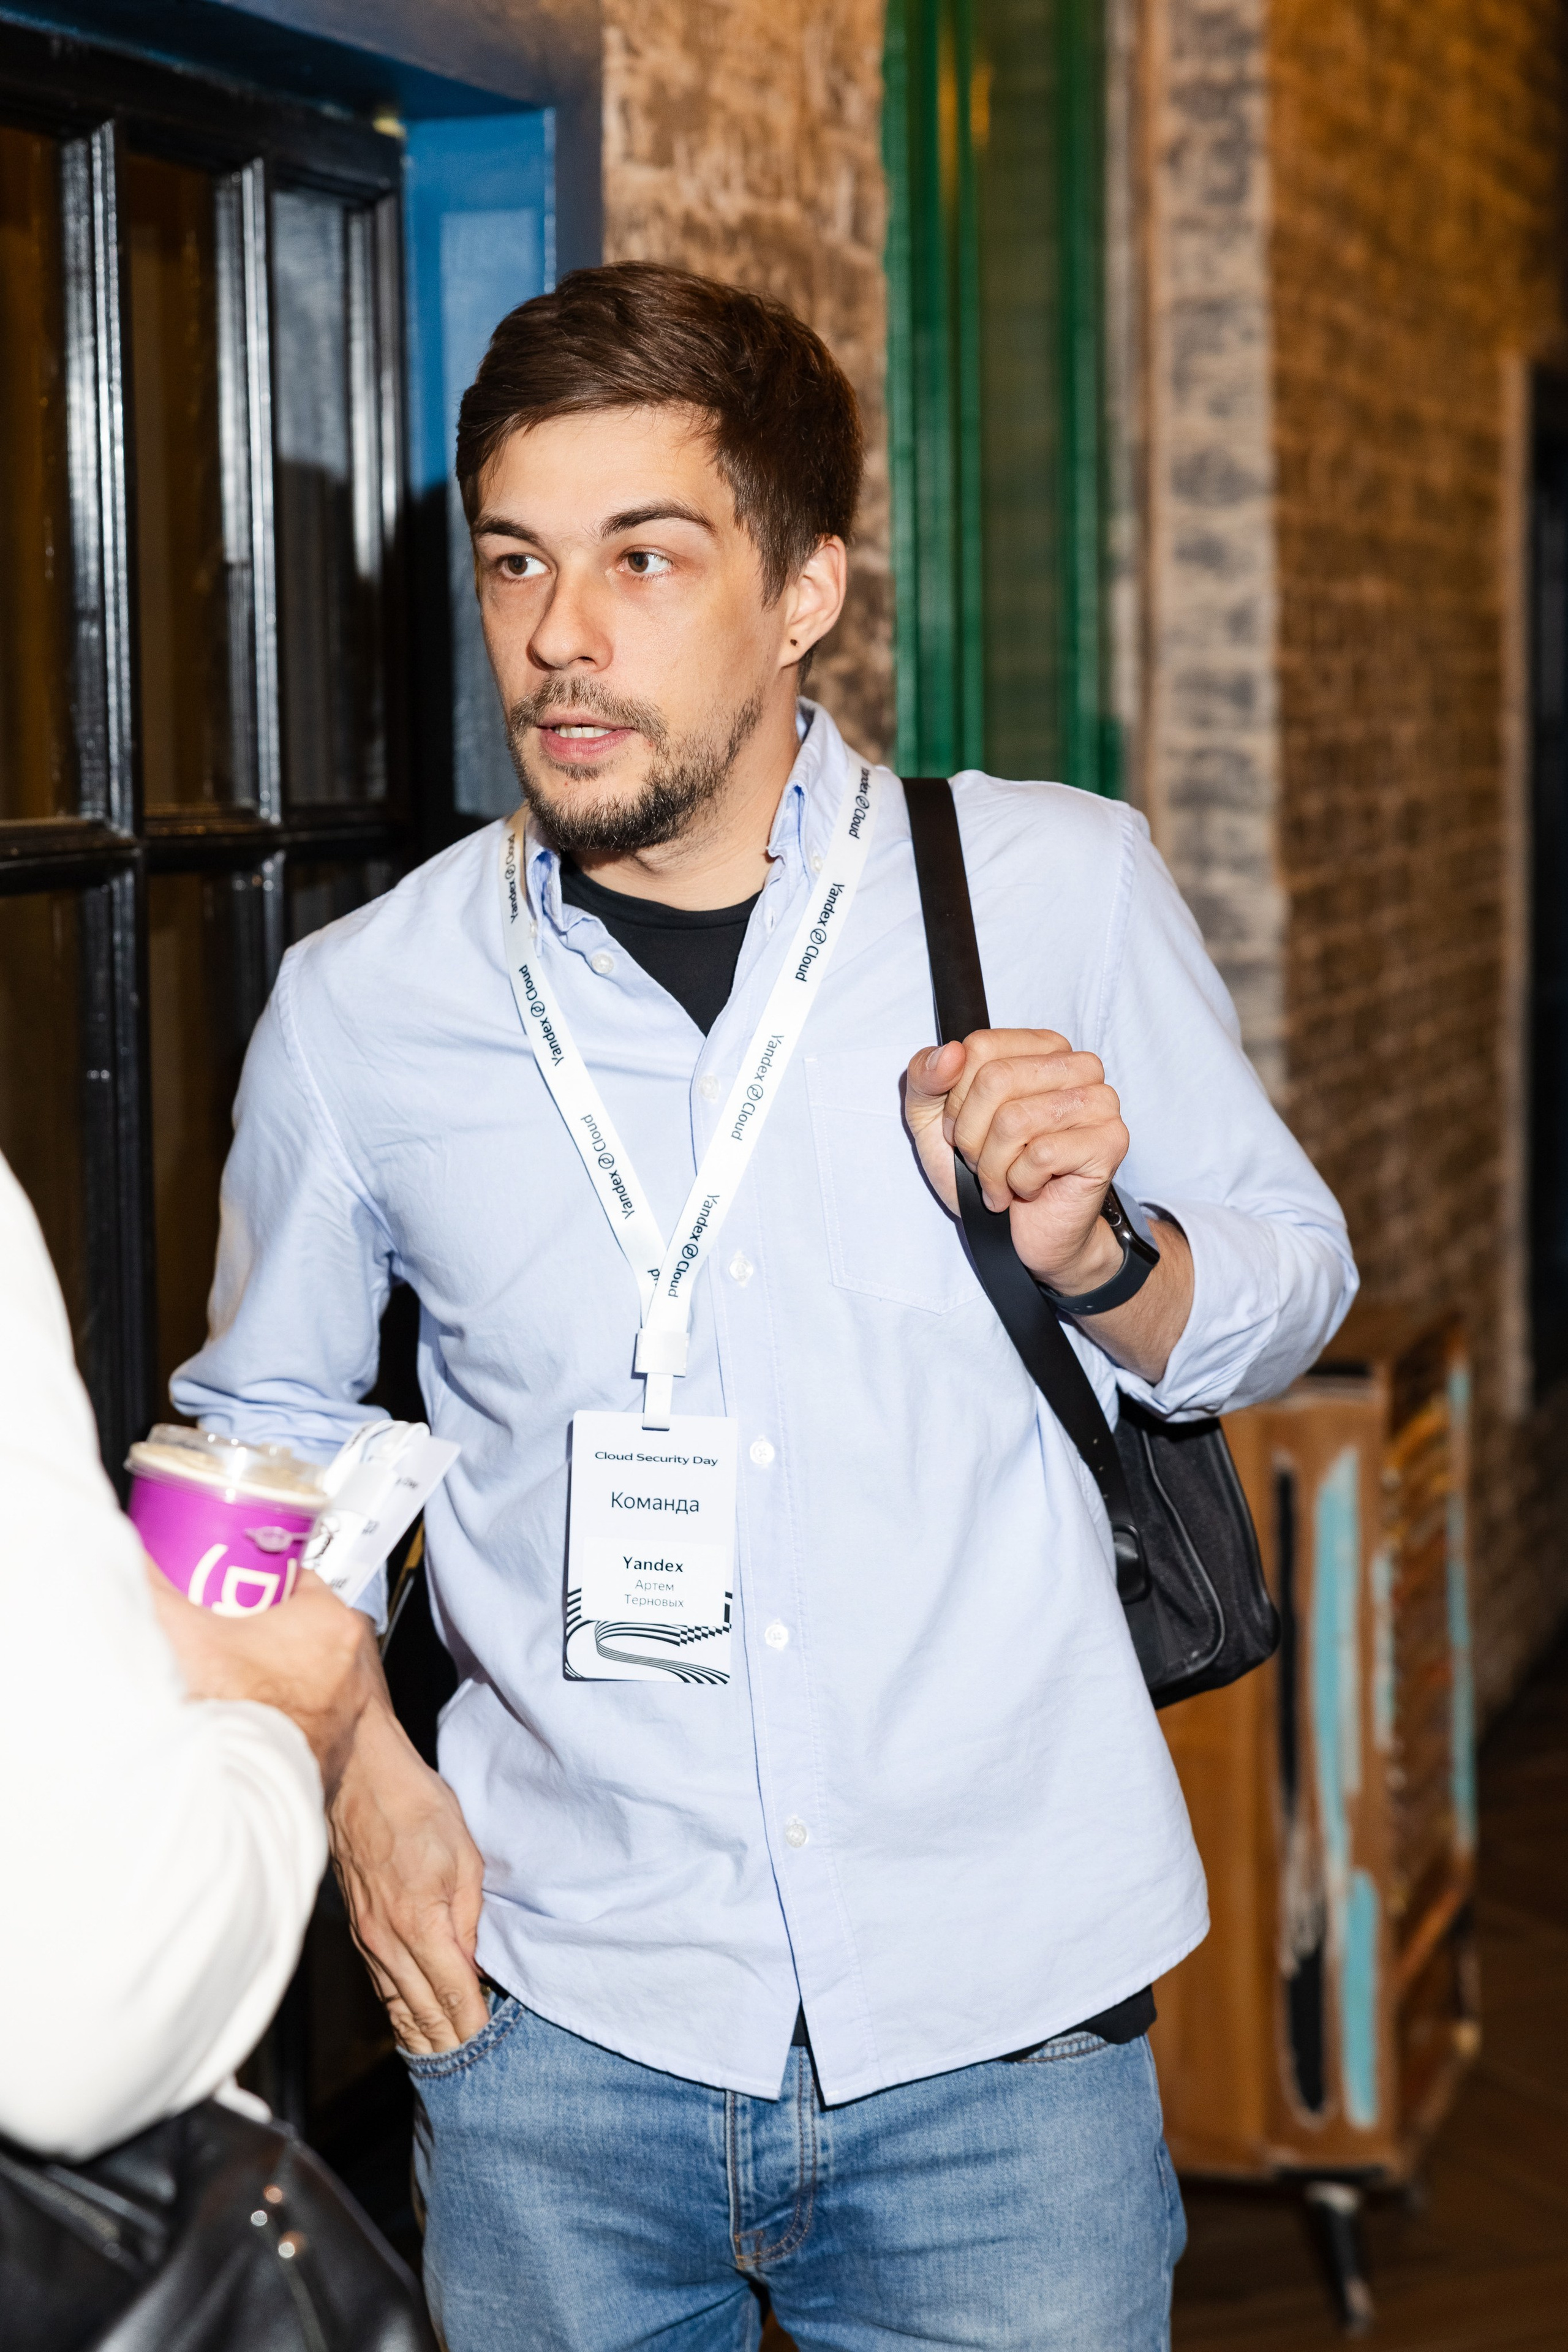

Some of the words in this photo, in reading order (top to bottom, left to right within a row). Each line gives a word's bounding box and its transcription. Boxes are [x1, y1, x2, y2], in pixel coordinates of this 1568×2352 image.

[848, 808, 866, 839] Cloud
[507, 877, 519, 925] Yandex
[817, 883, 845, 927] Yandex
[518, 963, 538, 1001] Cloud
[794, 945, 819, 982] Cloud
[540, 1017, 564, 1066] Yandex
[754, 1035, 784, 1082] Yandex
[580, 1114, 606, 1152] Cloud
[731, 1102, 755, 1140] Cloud
[608, 1169, 635, 1219] Yandex
[689, 1195, 720, 1242] Yandex
[668, 1261, 690, 1298] Cloud
[595, 1451, 633, 1461] Cloud
[636, 1453, 690, 1466] Security
[693, 1456, 718, 1467] Day
[611, 1491, 699, 1515] Команда
[623, 1556, 684, 1573] Yandex
[624, 1594, 684, 1608] Терновых
[635, 1579, 674, 1592] Артем
